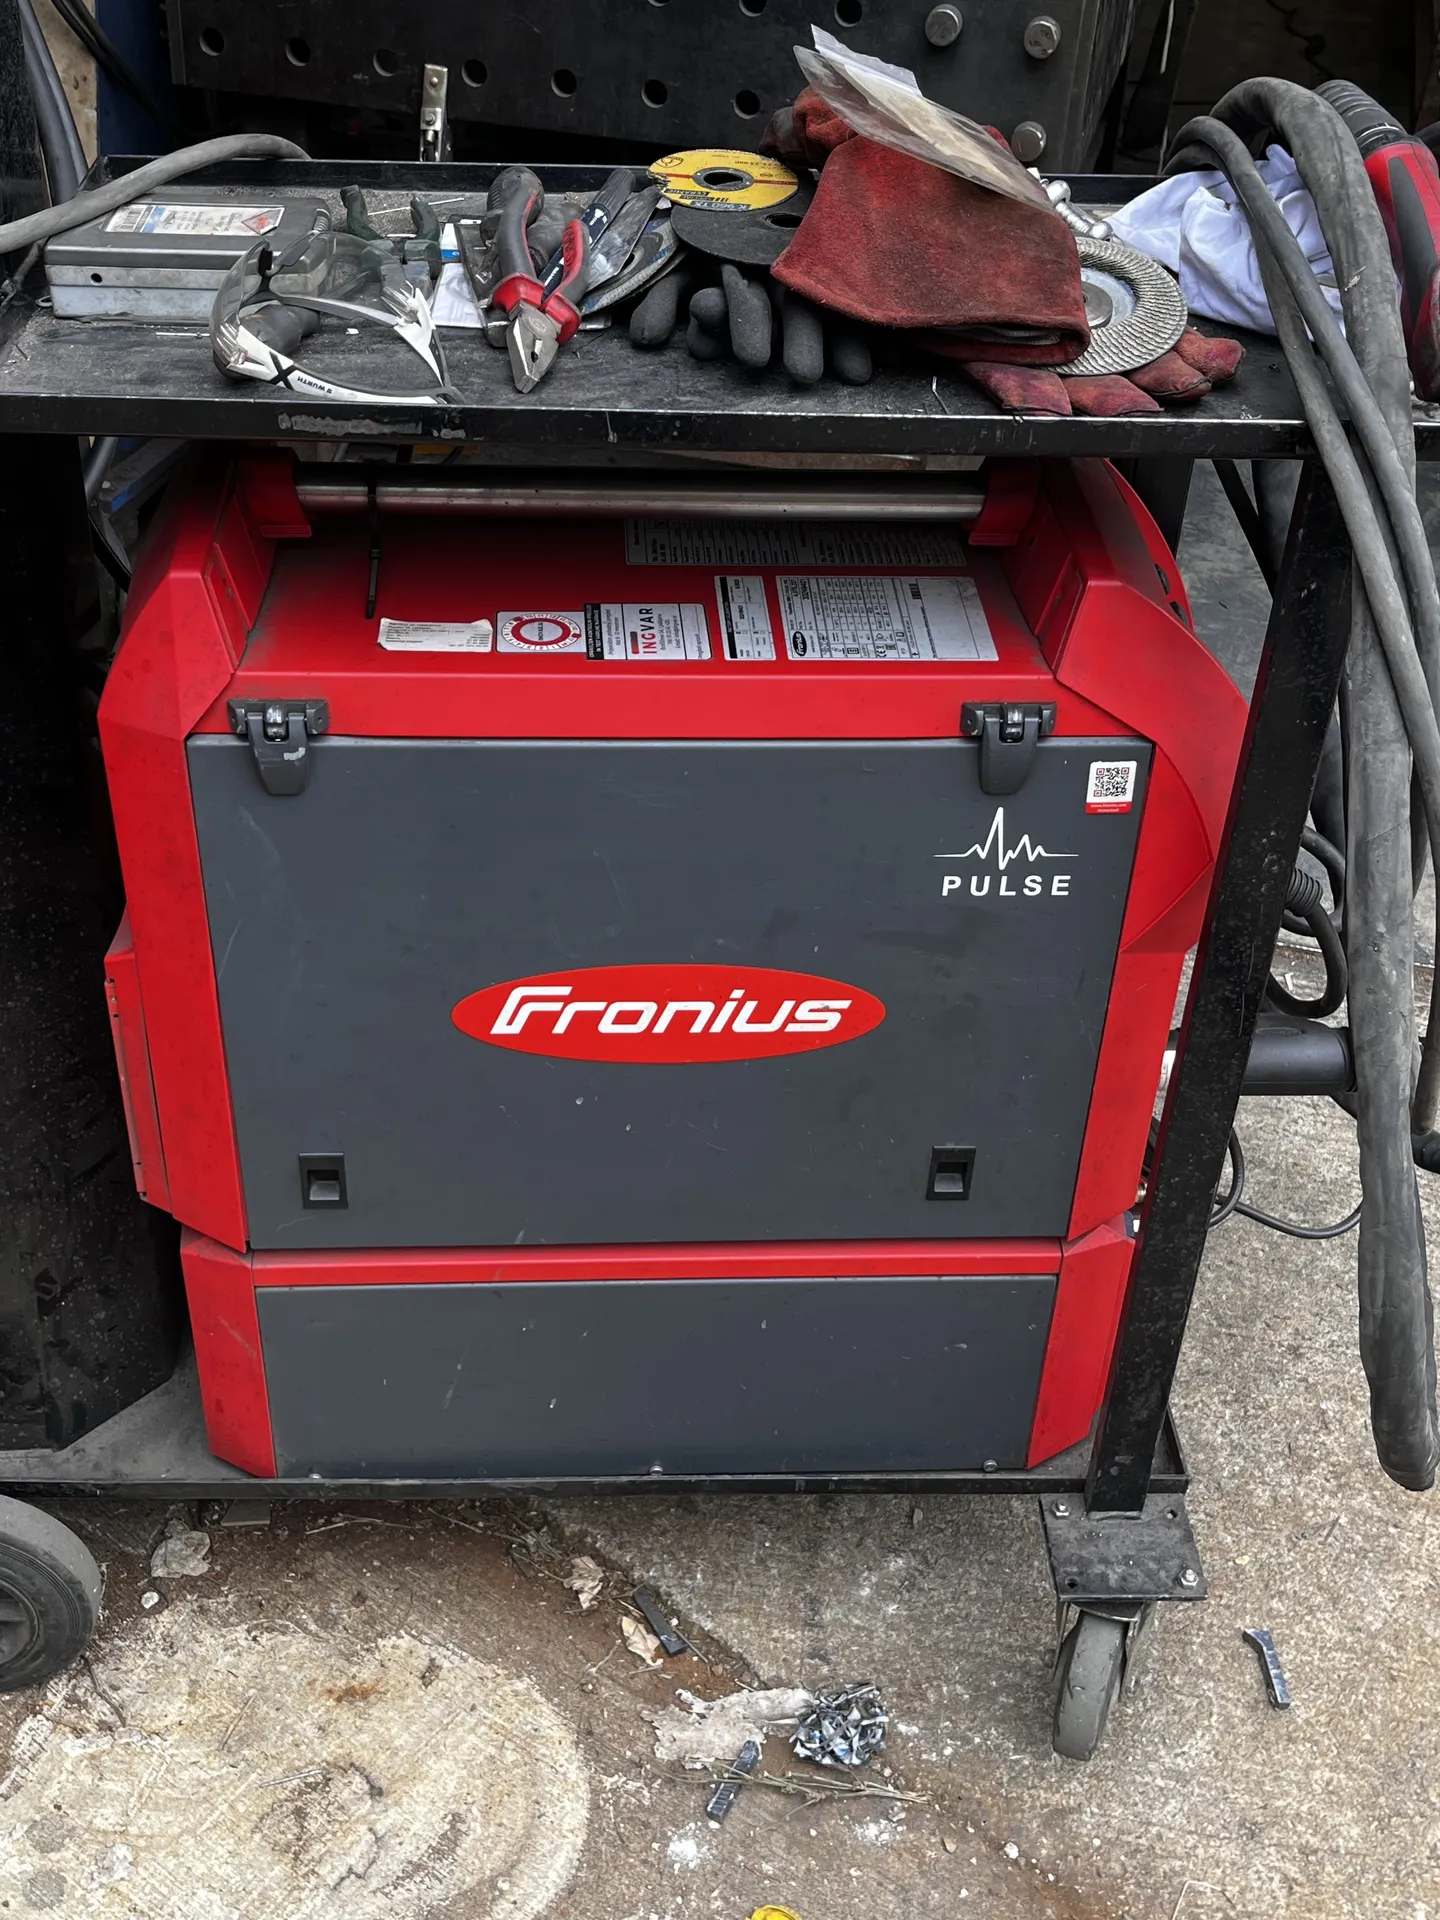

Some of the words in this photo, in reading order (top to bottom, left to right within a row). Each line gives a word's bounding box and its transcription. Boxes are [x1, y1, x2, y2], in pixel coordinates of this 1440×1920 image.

[639, 608, 657, 654] INGVAR
[942, 875, 1072, 896] PULSE
[490, 986, 852, 1034] Fronius
